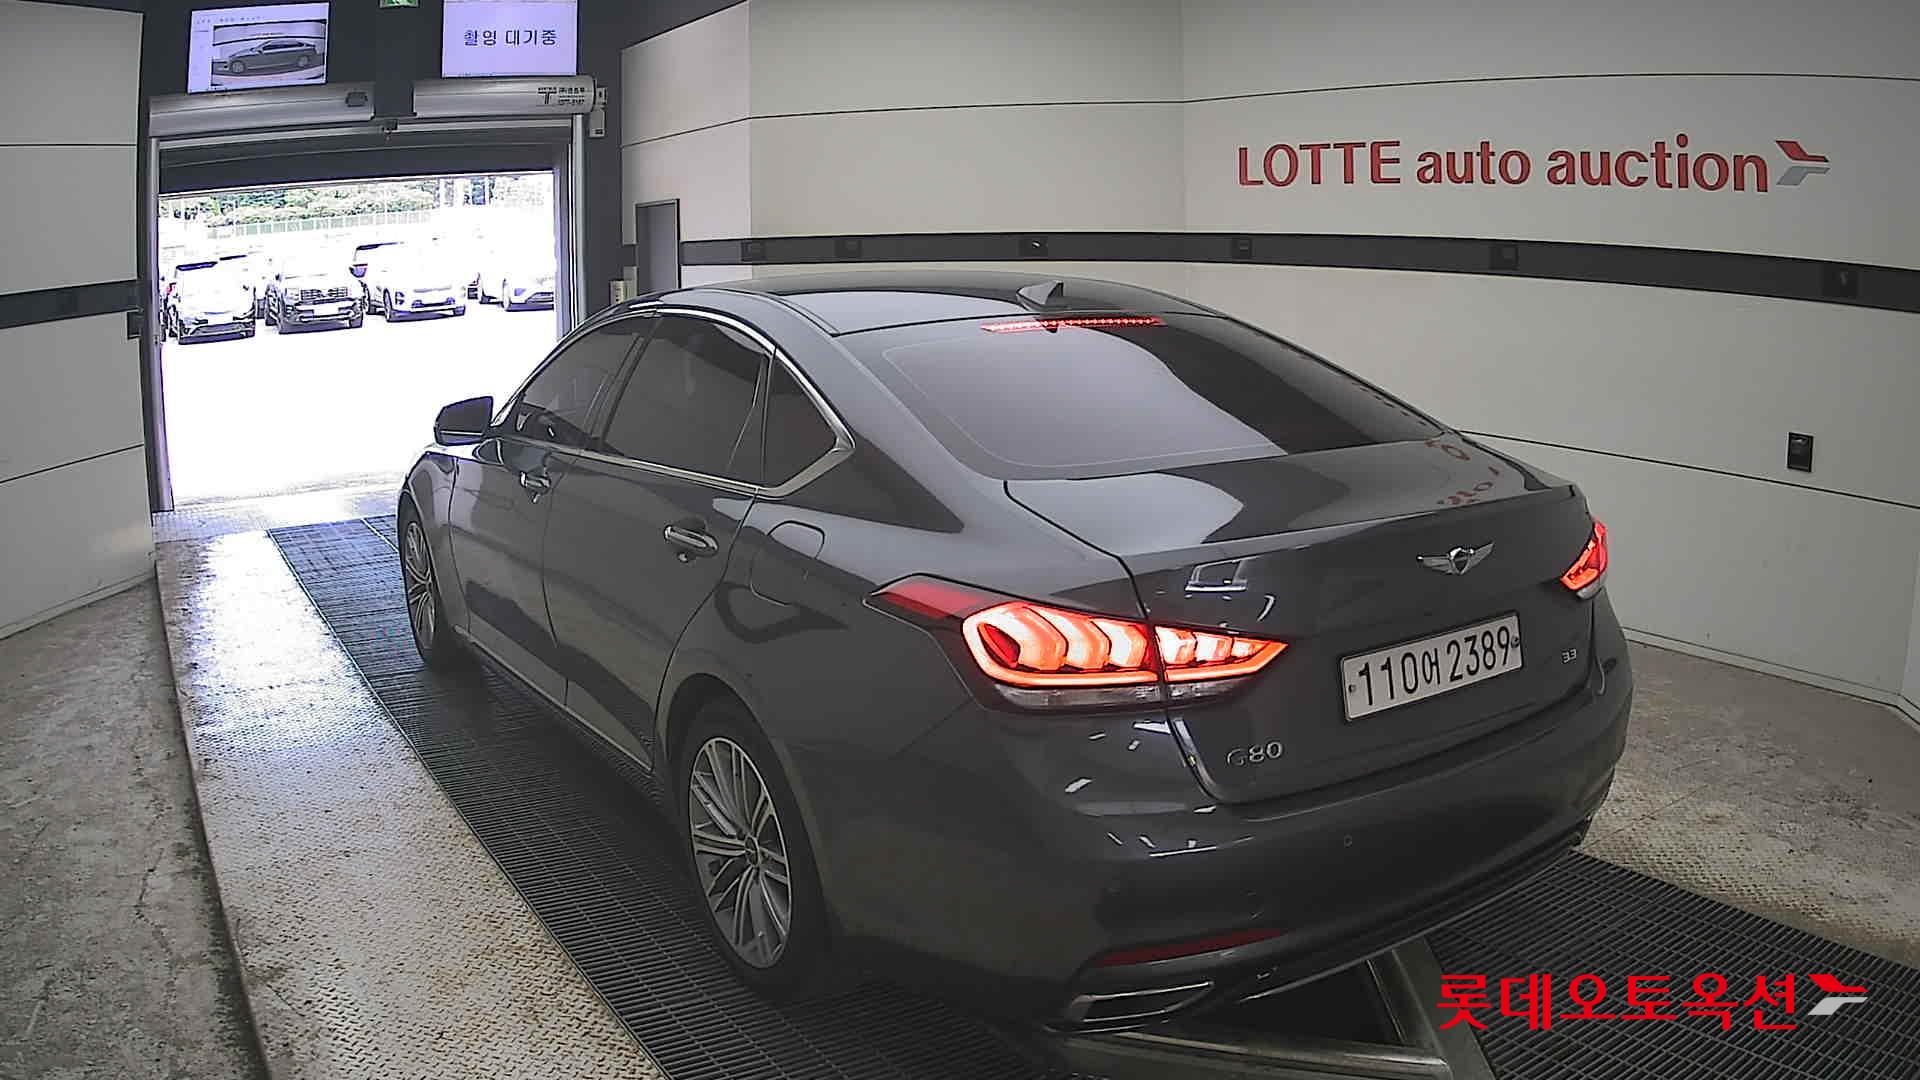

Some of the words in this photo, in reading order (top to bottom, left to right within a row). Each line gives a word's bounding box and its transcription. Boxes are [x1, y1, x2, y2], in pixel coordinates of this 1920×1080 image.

[505, 29, 557, 46] 대기중
[1238, 140, 1401, 187] LOTTE
[1416, 141, 1532, 186] auto
[1546, 133, 1770, 193] auction
[1227, 741, 1282, 766] G80
